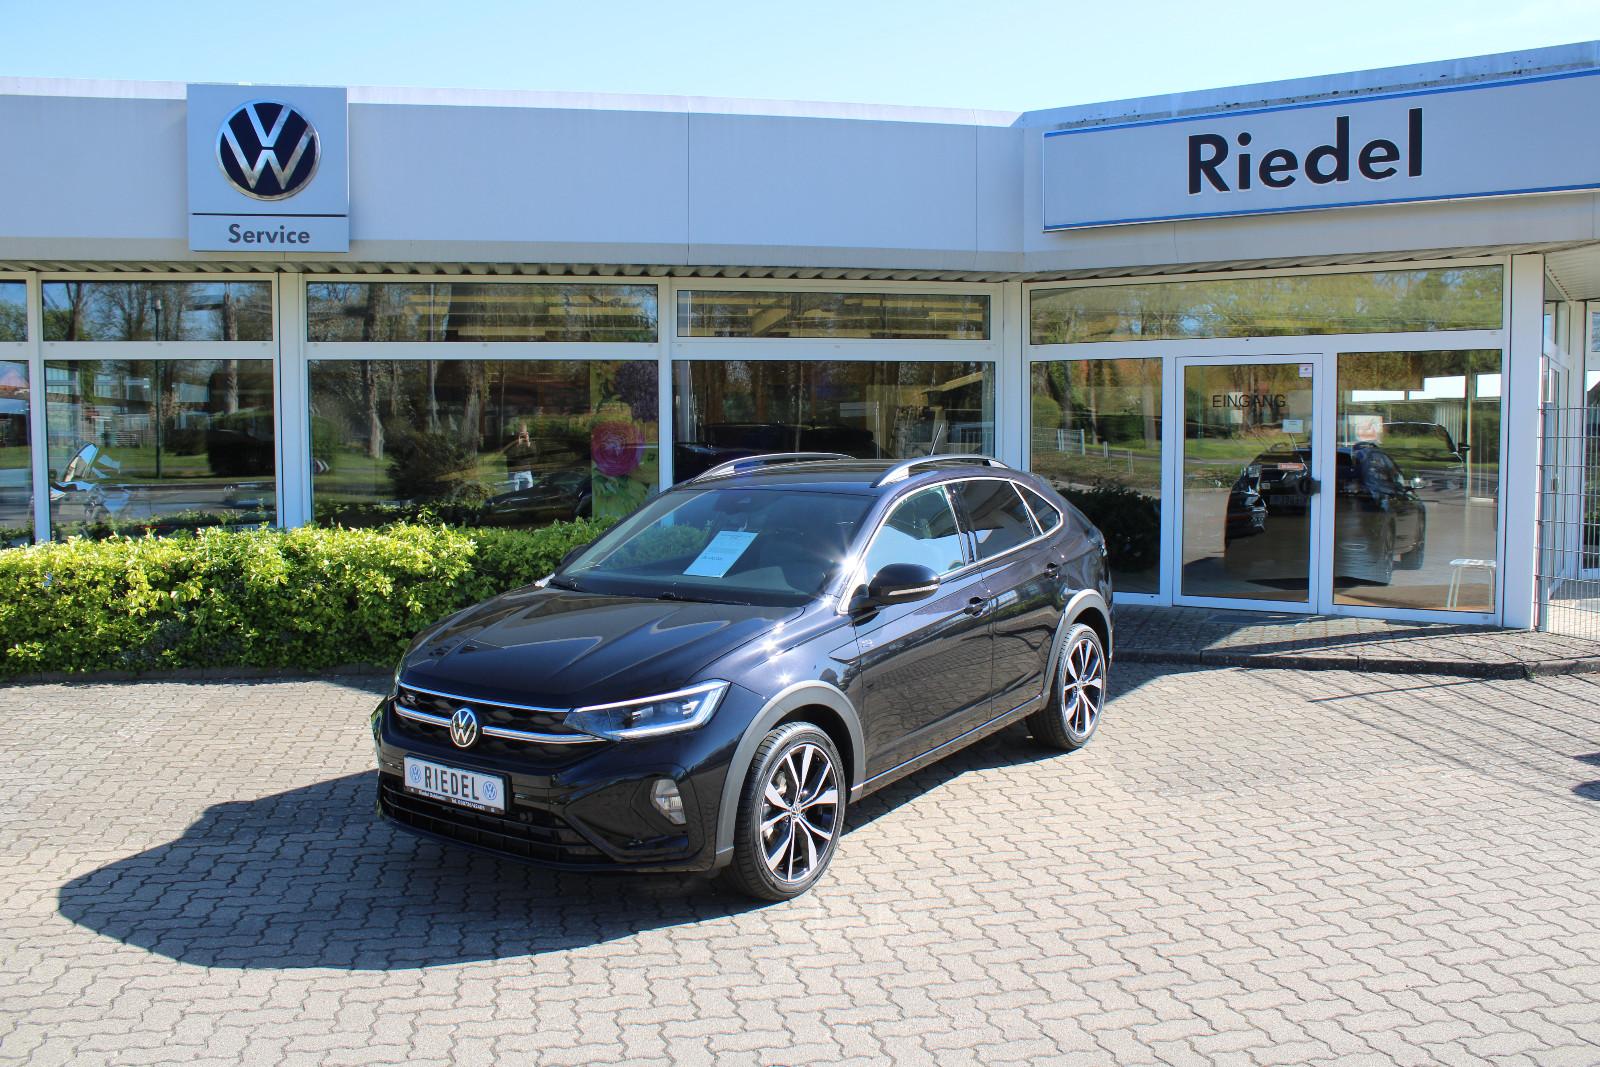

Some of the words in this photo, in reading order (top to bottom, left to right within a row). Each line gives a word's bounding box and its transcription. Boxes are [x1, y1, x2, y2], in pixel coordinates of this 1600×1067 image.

[218, 101, 318, 198] VW
[1188, 107, 1423, 194] Riedel
[228, 223, 310, 244] Service
[1212, 394, 1286, 408] EINGANG
[450, 708, 477, 747] VW
[424, 765, 480, 800] RIEDEL
